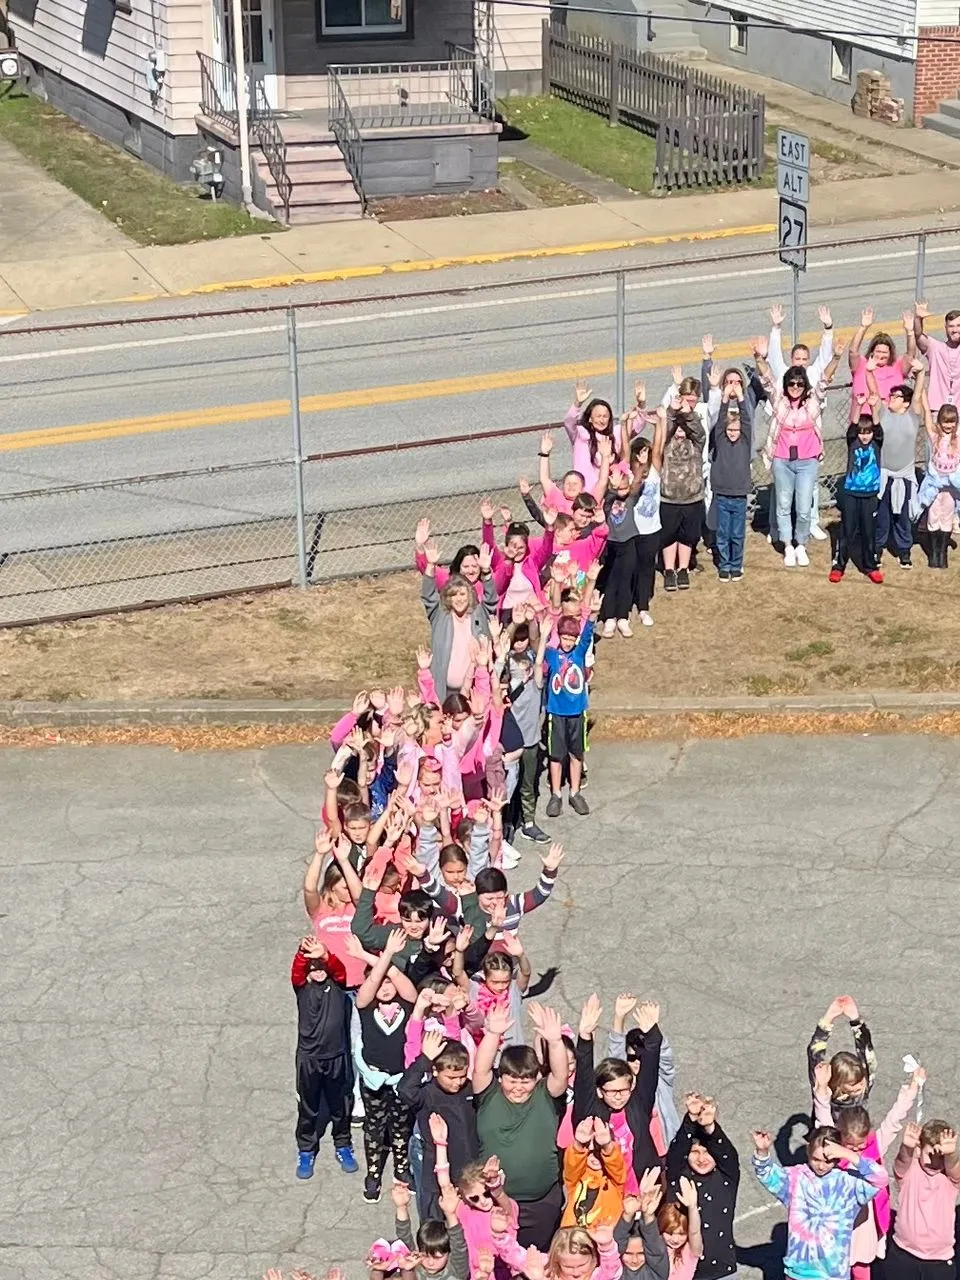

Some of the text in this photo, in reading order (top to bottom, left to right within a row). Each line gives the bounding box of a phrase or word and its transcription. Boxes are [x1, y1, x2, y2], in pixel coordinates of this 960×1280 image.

[781, 135, 806, 162] EAST
[783, 172, 803, 194] ALT
[782, 215, 804, 254] 27
